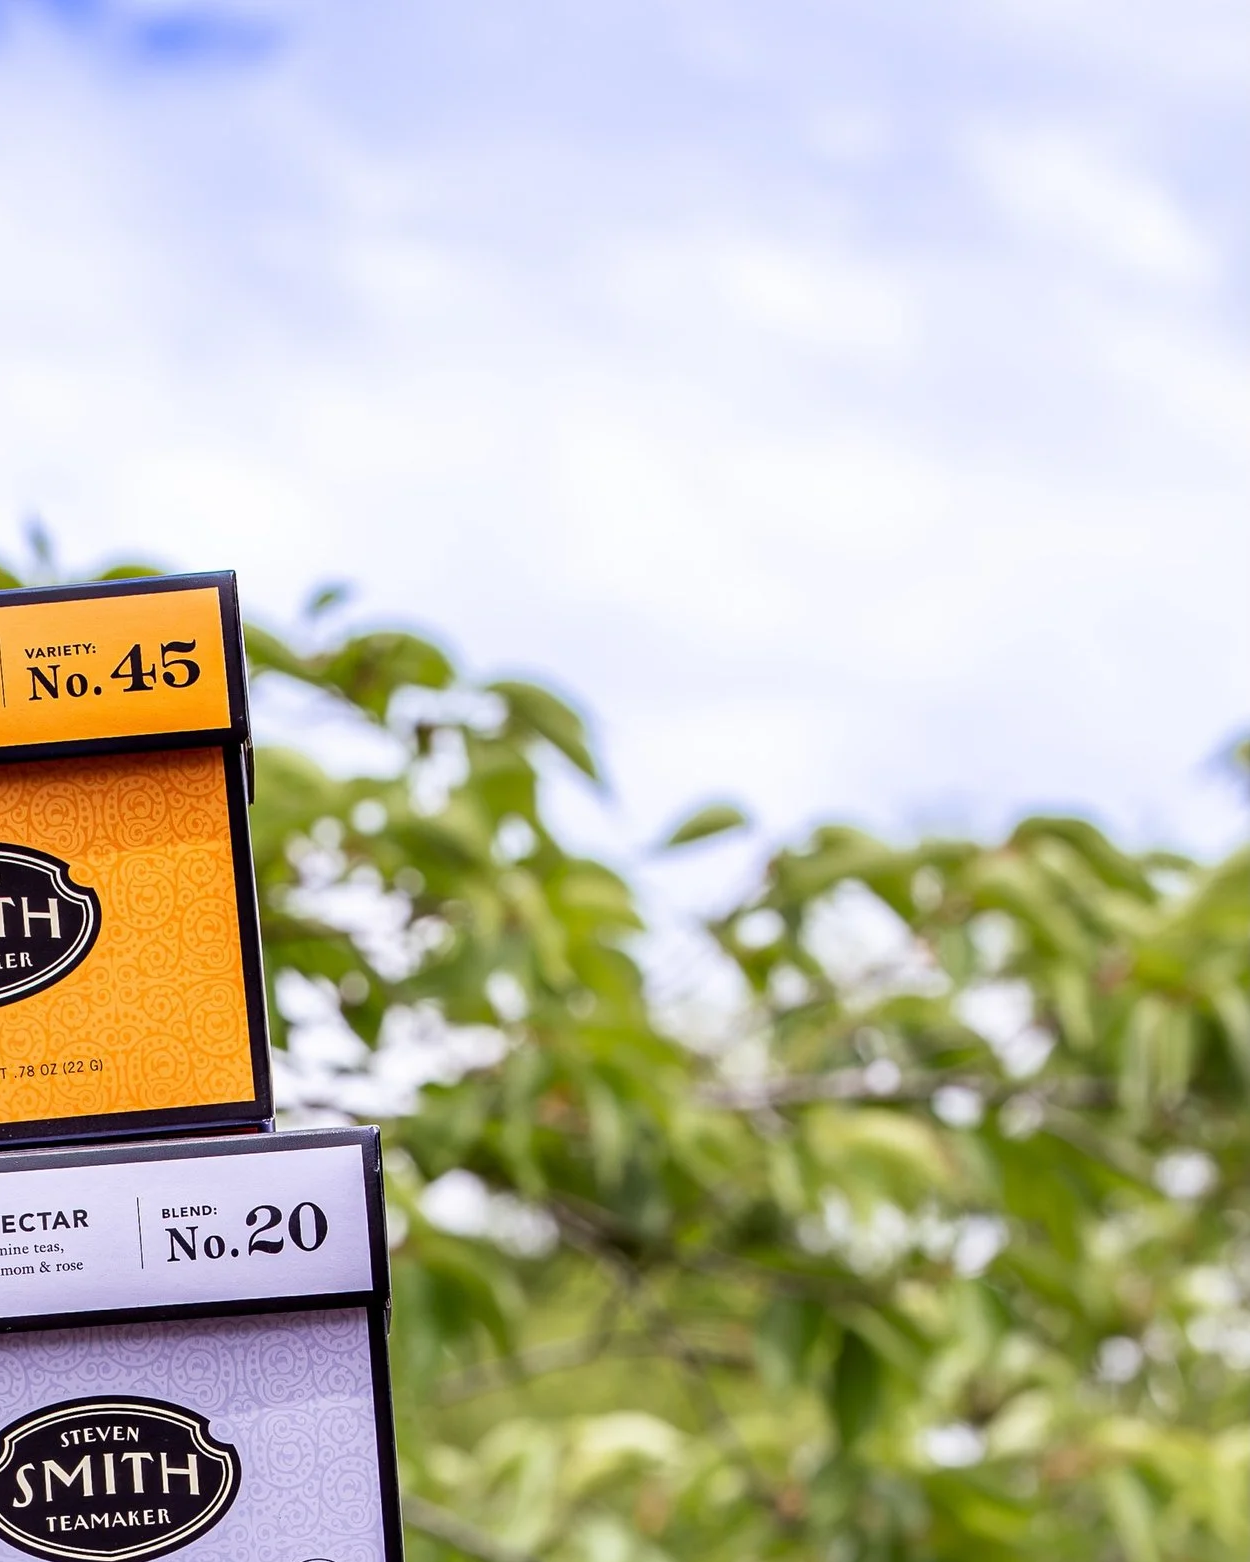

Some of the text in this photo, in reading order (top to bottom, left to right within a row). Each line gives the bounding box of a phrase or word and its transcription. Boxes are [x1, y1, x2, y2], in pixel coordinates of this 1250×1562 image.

[25, 643, 96, 659] VARIETY:
[14, 1065, 35, 1079] .78
[40, 1063, 57, 1075] OZ
[63, 1061, 84, 1074] (22
[90, 1059, 103, 1071] G)
[162, 1206, 217, 1218] BLEND:
[33, 1240, 64, 1256] teas,
[40, 1262, 51, 1273] &
[56, 1262, 83, 1271] rose
[61, 1426, 138, 1447] STEVEN
[13, 1453, 199, 1507] SMITH
[46, 1509, 171, 1532] TEAMAKER
